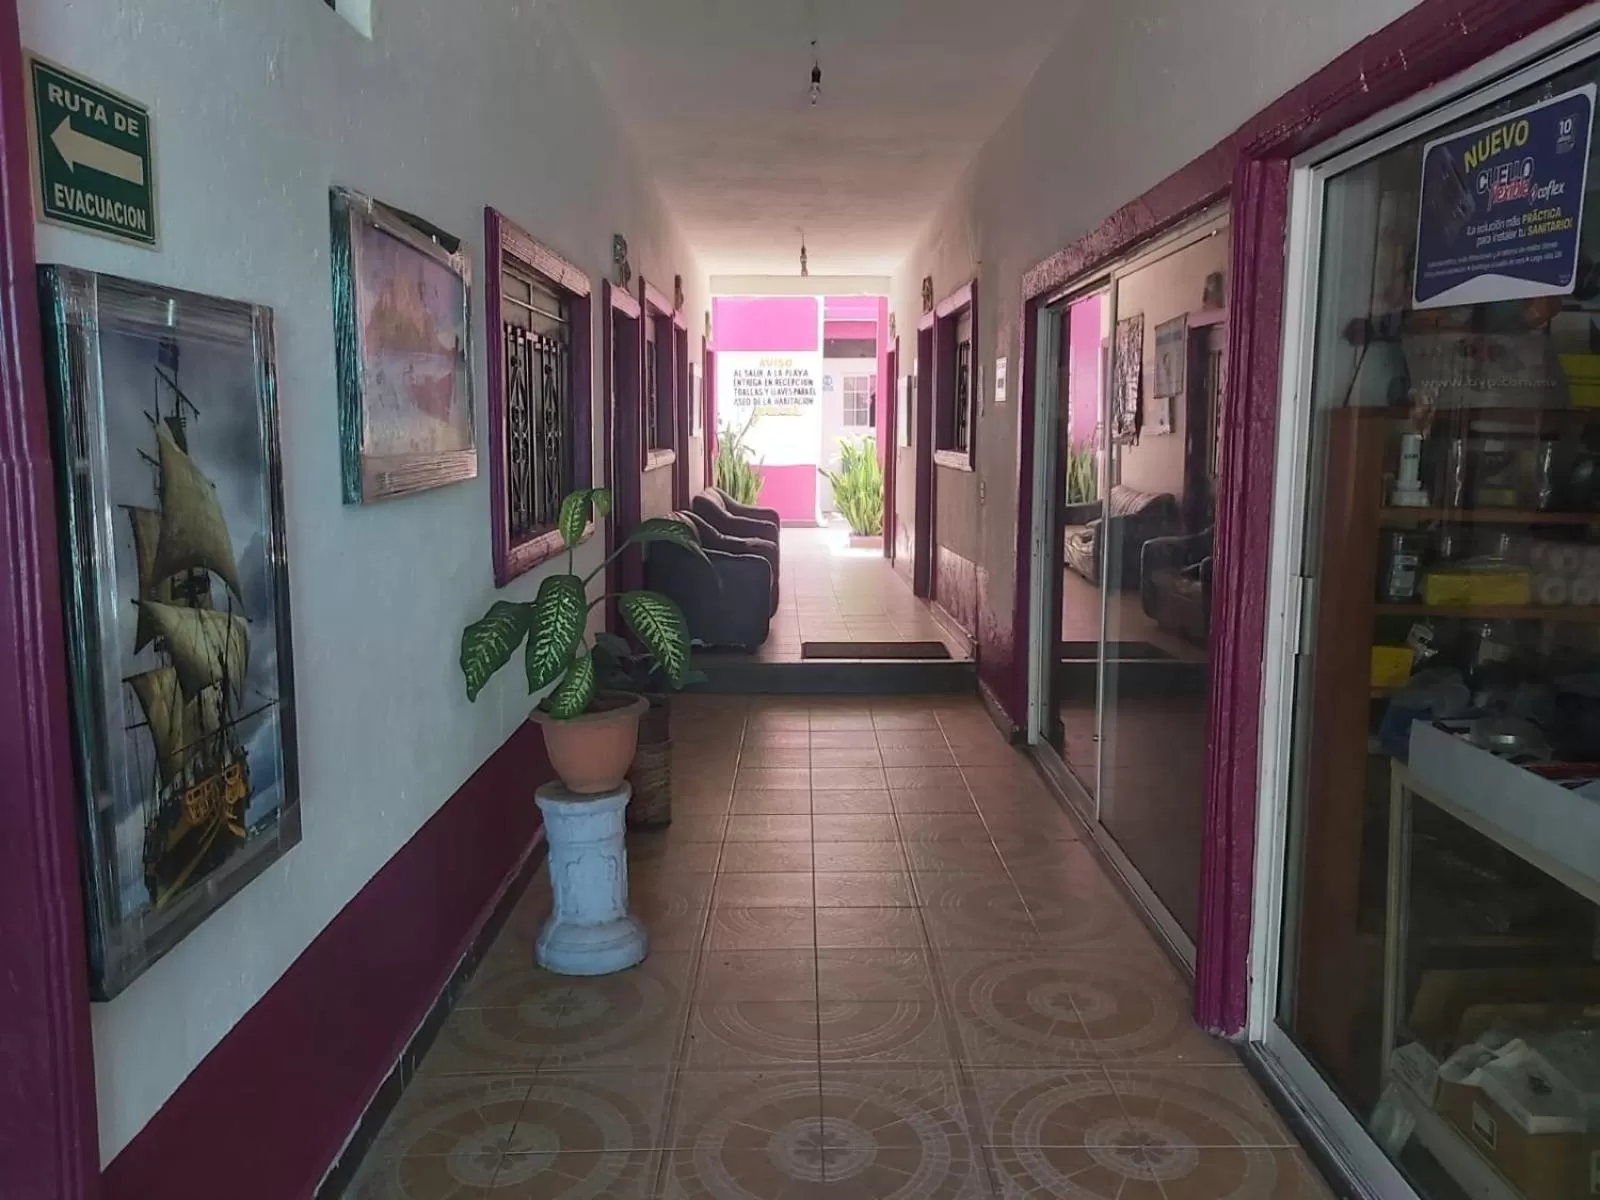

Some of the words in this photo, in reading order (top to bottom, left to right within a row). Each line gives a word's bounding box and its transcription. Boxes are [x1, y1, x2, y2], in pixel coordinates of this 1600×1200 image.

[47, 82, 109, 126] RUTA
[114, 112, 140, 138] DE
[1559, 118, 1572, 136] 10
[1464, 119, 1530, 174] NUEVO
[1475, 156, 1535, 195] CUELLO
[1537, 179, 1566, 200] coflex
[53, 182, 147, 231] EVACUACION
[1522, 206, 1562, 225] PRÁCTICA
[733, 369, 742, 377] AL
[766, 369, 772, 377] A
[774, 369, 782, 377] LA
[785, 369, 809, 377] PLAYA
[759, 358, 793, 368] AVISO
[764, 378, 773, 387] EN
